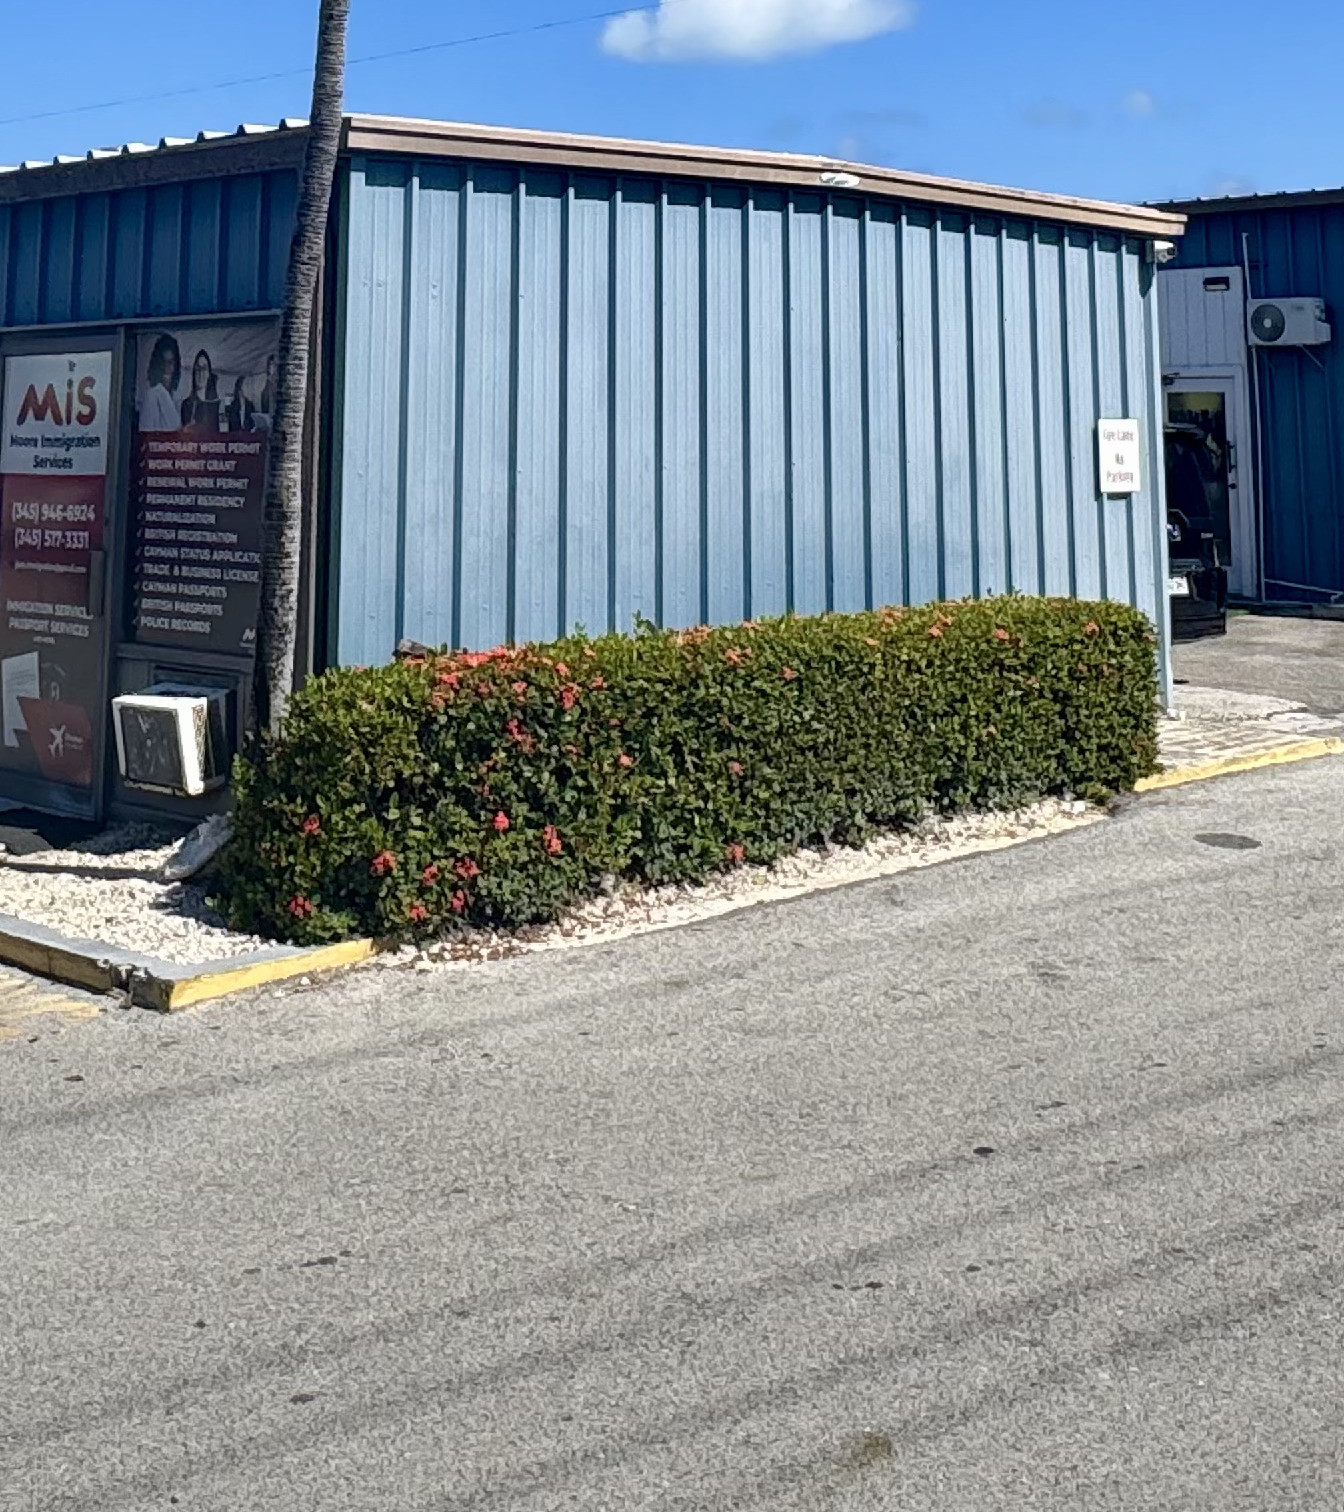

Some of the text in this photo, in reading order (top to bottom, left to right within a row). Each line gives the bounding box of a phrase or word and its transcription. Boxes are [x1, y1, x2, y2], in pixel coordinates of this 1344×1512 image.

[40, 432, 101, 452] Immigration
[148, 441, 261, 455] TEMPORARY WORK PERMIT
[33, 454, 74, 469] Services
[174, 459, 206, 471] PERMIT
[187, 477, 215, 489] WORK
[216, 478, 250, 490] PERMIT
[146, 493, 196, 506] PERMANENT
[12, 501, 40, 525] (345)
[15, 526, 42, 551] (345)
[144, 545, 179, 558] CAYMAN
[180, 547, 211, 561] STATUS
[143, 580, 178, 594] CAYMAN
[50, 620, 90, 638] SERVICES
[141, 616, 170, 630] POLICE
